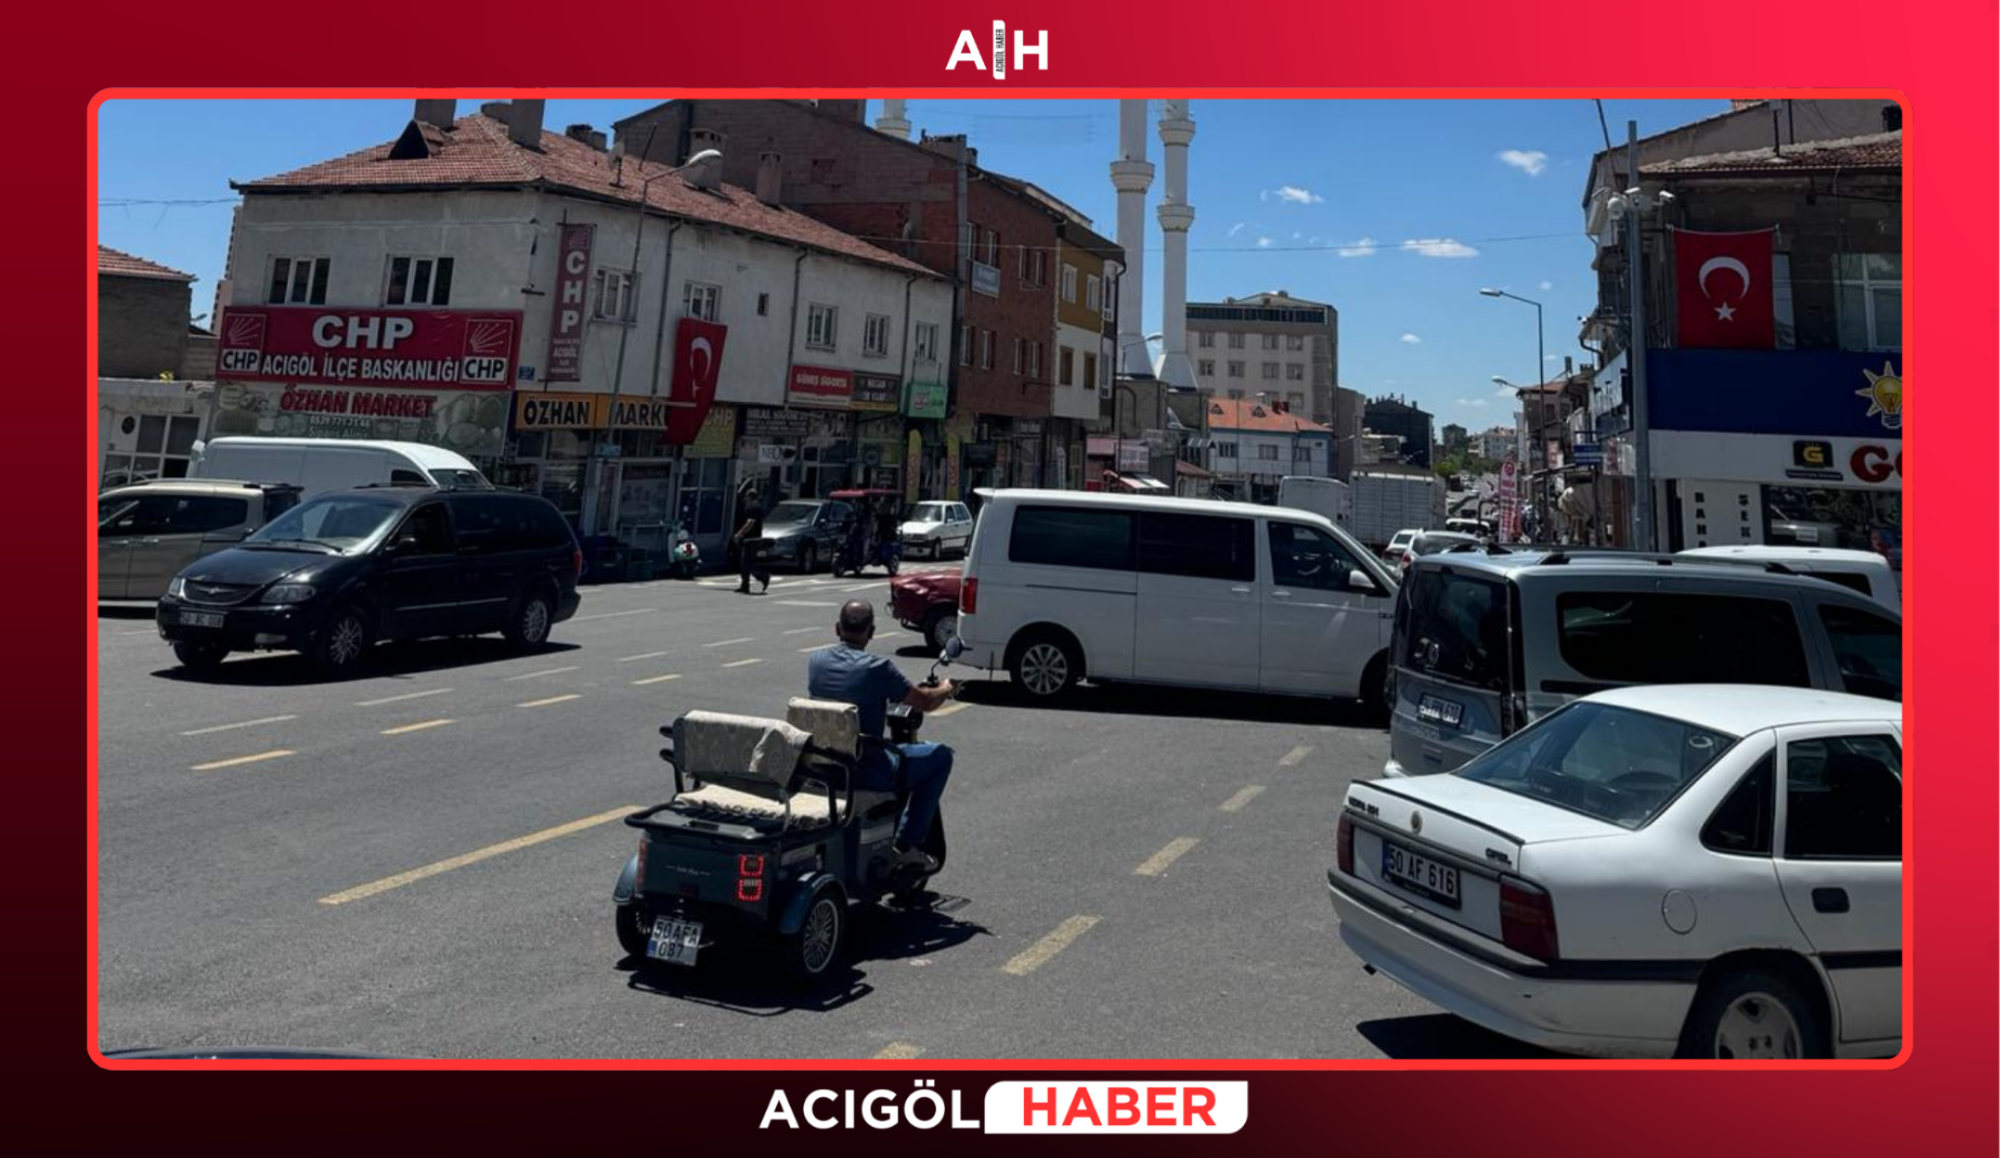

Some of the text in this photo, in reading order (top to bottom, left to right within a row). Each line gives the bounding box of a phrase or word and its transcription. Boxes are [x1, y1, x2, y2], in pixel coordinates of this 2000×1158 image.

[560, 251, 585, 333] CHP
[312, 315, 414, 349] CHP
[222, 350, 258, 370] CHP
[262, 352, 318, 377] ACIGÖL
[322, 353, 356, 382] İLÇE
[464, 358, 505, 379] CHP
[280, 385, 437, 417] ÖZHAN MARKET
[524, 396, 590, 425] ÖZHAN
[1738, 494, 1751, 546] ŞEK
[1388, 848, 1403, 873] 50
[1408, 857, 1423, 881] AF
[1428, 863, 1454, 894] 616
